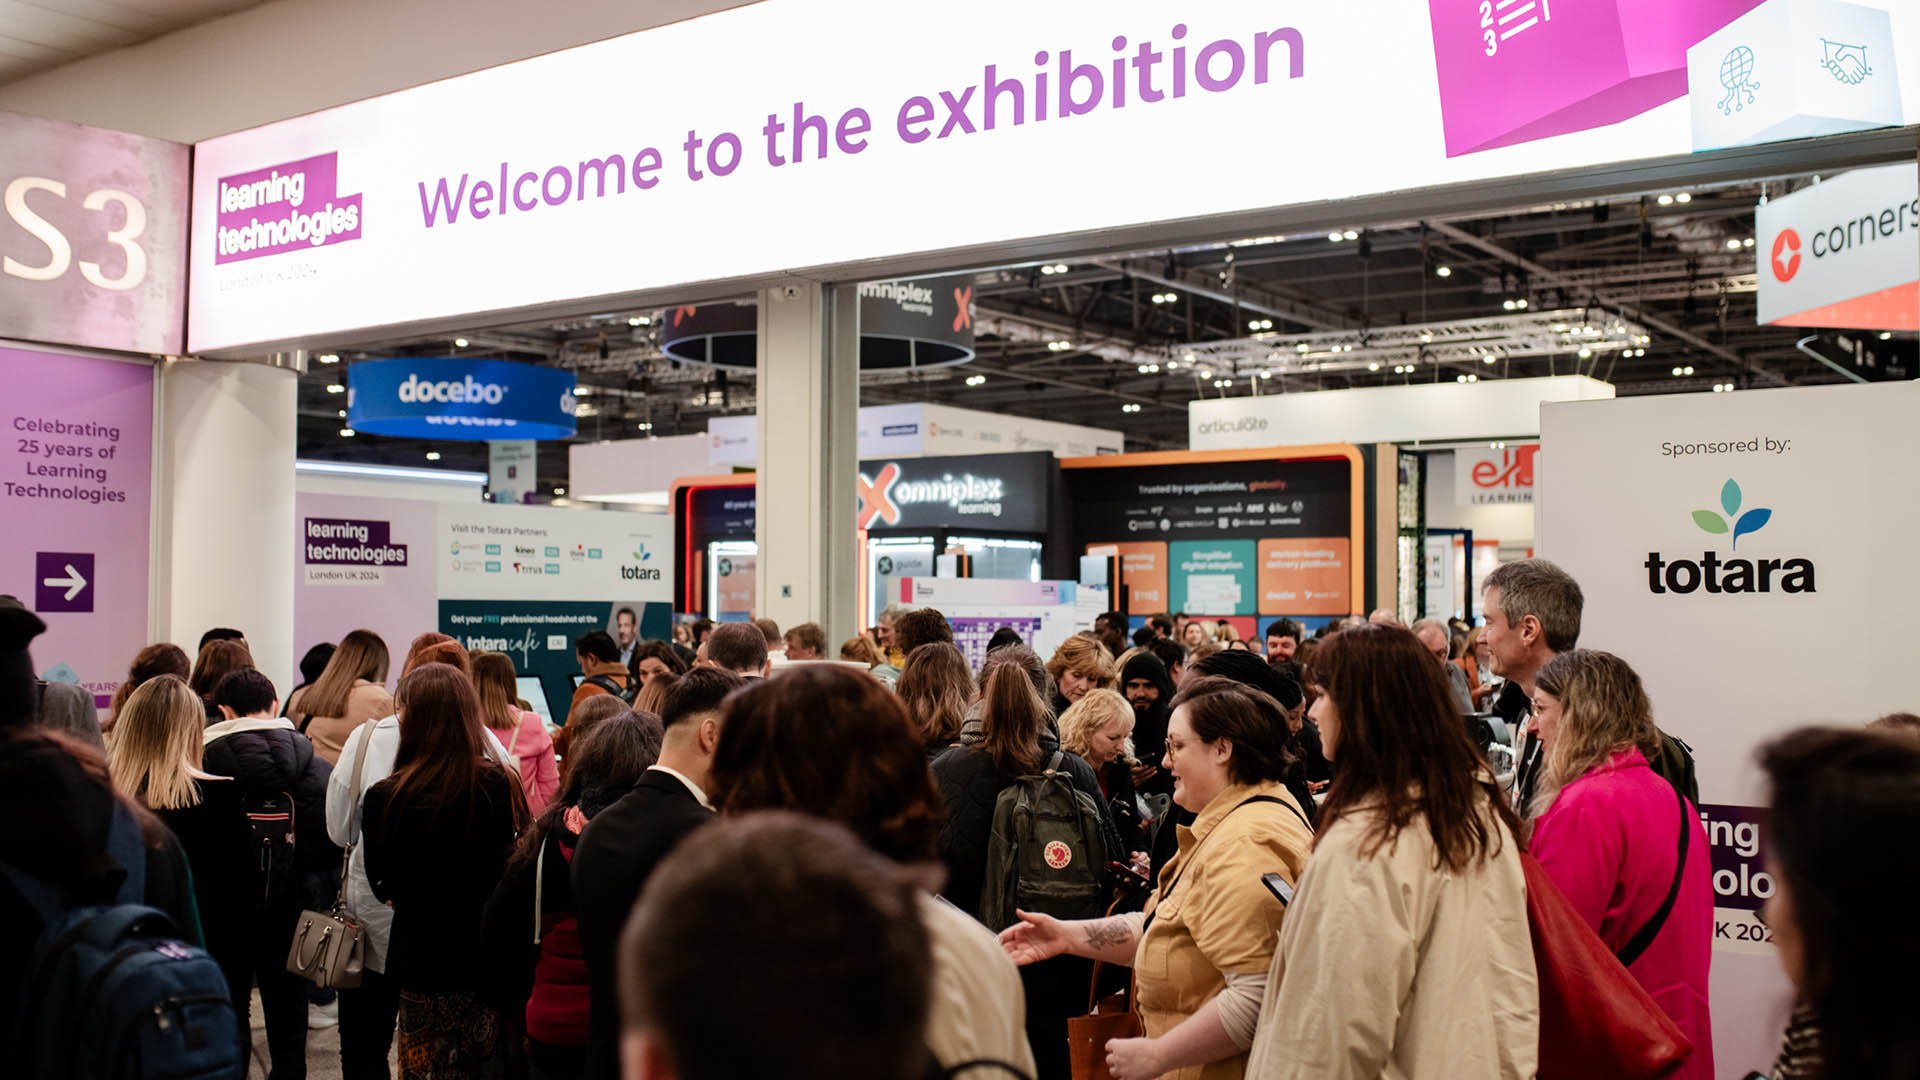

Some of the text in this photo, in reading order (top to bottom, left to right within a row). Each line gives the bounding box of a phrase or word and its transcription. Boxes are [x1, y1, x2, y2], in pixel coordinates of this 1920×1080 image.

[418, 24, 1304, 228] Welcome to the exhibition
[220, 171, 305, 214] learning
[3, 176, 148, 291] S3
[218, 202, 358, 255] technologies
[399, 374, 502, 404] docebo
[13, 417, 120, 441] Celebrating
[18, 439, 116, 459] 25 years of
[1661, 436, 1791, 459] Sponsored by:
[26, 462, 107, 483] Learning
[4, 482, 126, 504] Technologies
[894, 473, 1003, 507] omniplex
[1172, 484, 1183, 495] by
[957, 501, 1002, 516] learning
[307, 520, 369, 543] learning
[451, 525, 468, 533] Visit
[471, 525, 485, 534] the
[487, 526, 512, 535] Totara
[307, 543, 405, 565] technologies
[310, 571, 379, 581] London UK 2024
[621, 565, 660, 580] totara
[1644, 551, 1817, 594] totara
[451, 615, 598, 625] Get your FREE professional headshot at the
[466, 636, 507, 651] totara
